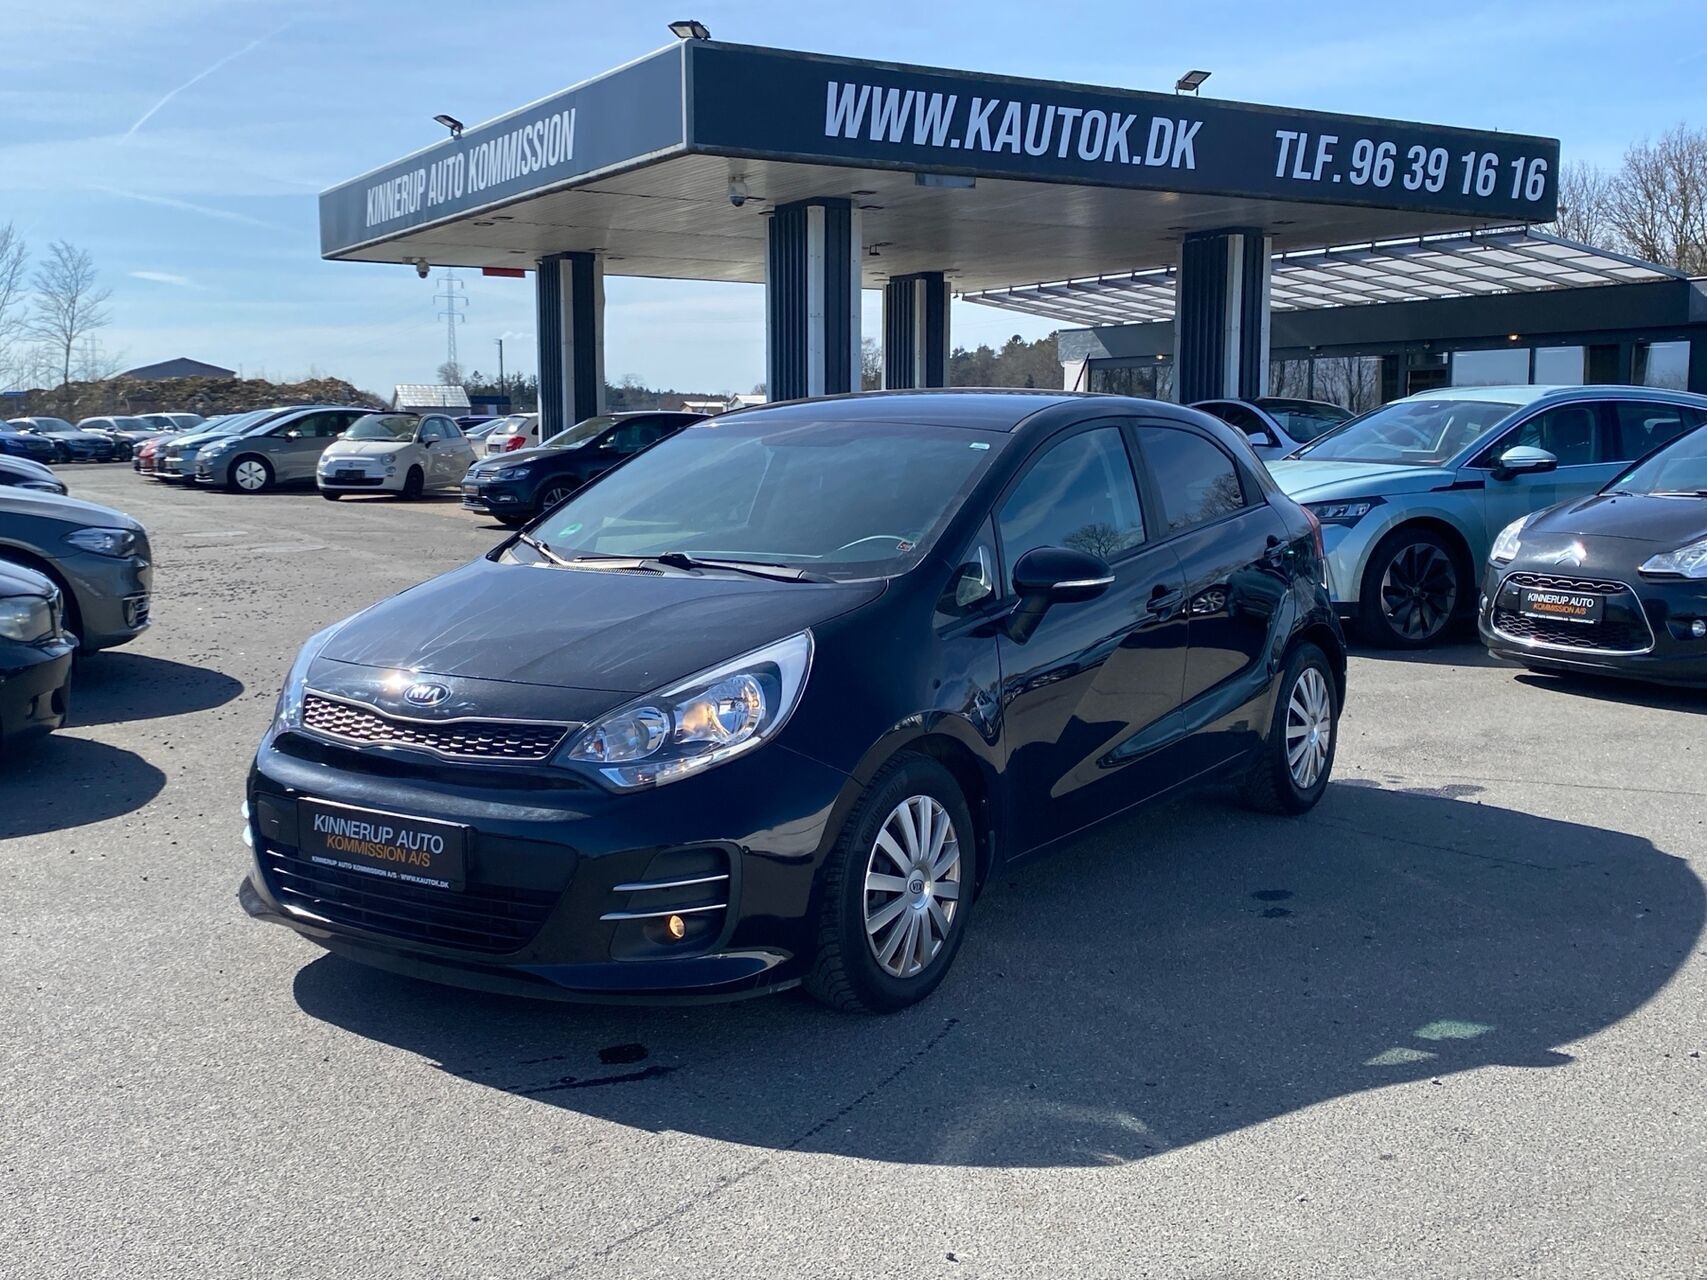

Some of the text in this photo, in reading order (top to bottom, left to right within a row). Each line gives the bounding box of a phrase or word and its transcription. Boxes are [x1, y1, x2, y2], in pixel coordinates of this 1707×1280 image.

[824, 81, 1204, 170] WWW.KAUTOK.DK
[366, 107, 577, 227] KINNERUP AUTO KOMMISSION
[1275, 129, 1548, 202] TLF. 96 39 16 16
[1527, 592, 1594, 608] KINNERUP AUTO
[1533, 603, 1574, 614] KOMMISSION
[313, 813, 444, 854] KINNERUP AUTO
[326, 834, 431, 867] KOMMISSION A/S
